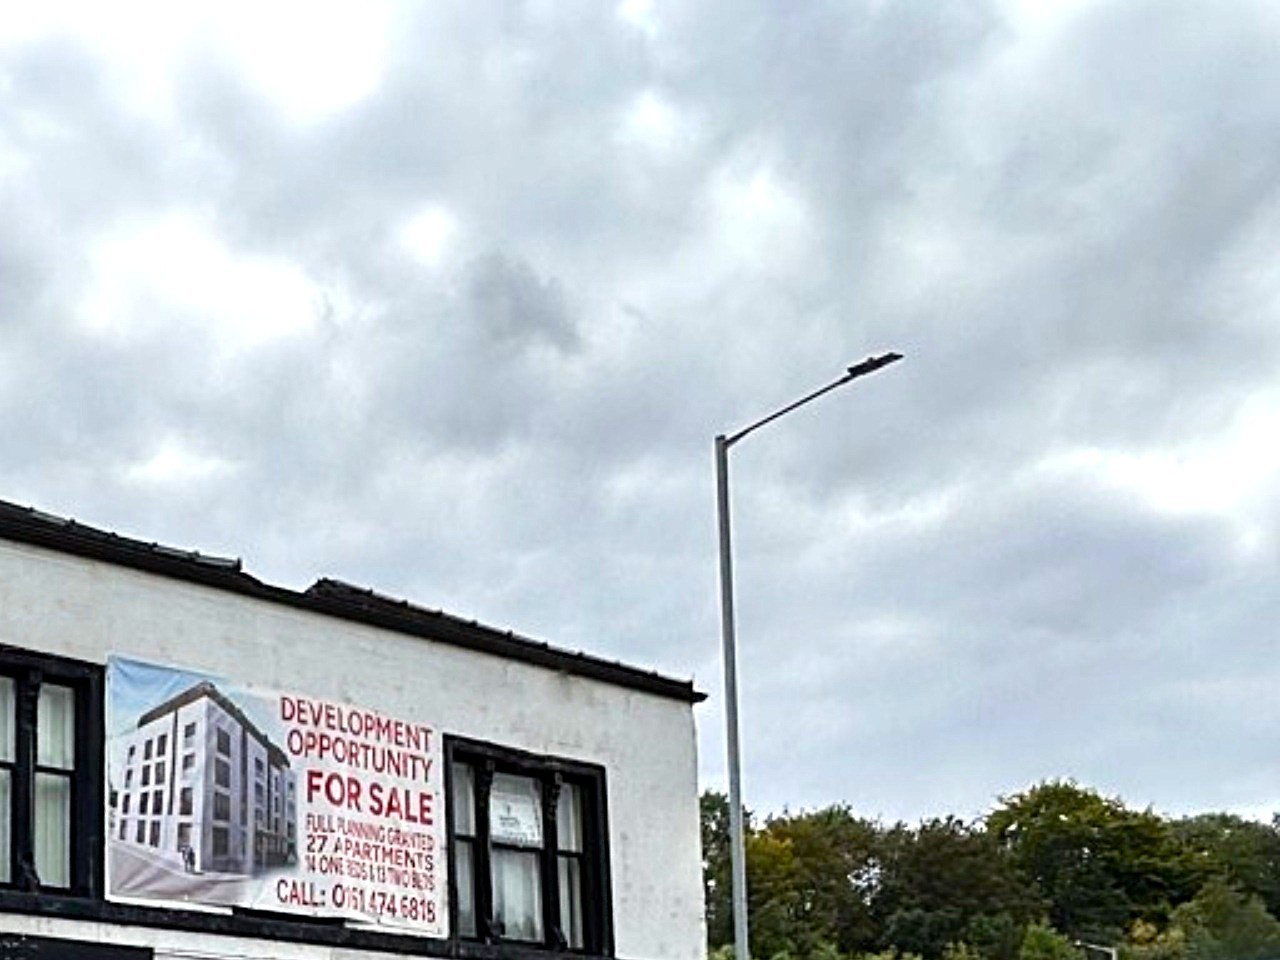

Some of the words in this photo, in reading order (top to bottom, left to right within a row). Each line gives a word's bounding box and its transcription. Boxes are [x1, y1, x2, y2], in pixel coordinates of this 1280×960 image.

[280, 696, 433, 752] DEVELOPMENT
[287, 729, 433, 783] OPPORTUNITY
[307, 770, 362, 812] FOR
[369, 782, 433, 826] SALE
[306, 812, 335, 834] FULL
[306, 834, 328, 854] 27
[333, 836, 434, 873] APARTMENTS
[319, 855, 343, 877] ONE
[276, 878, 326, 907] CALL:
[331, 883, 366, 914] 0161
[368, 890, 397, 919] 474
